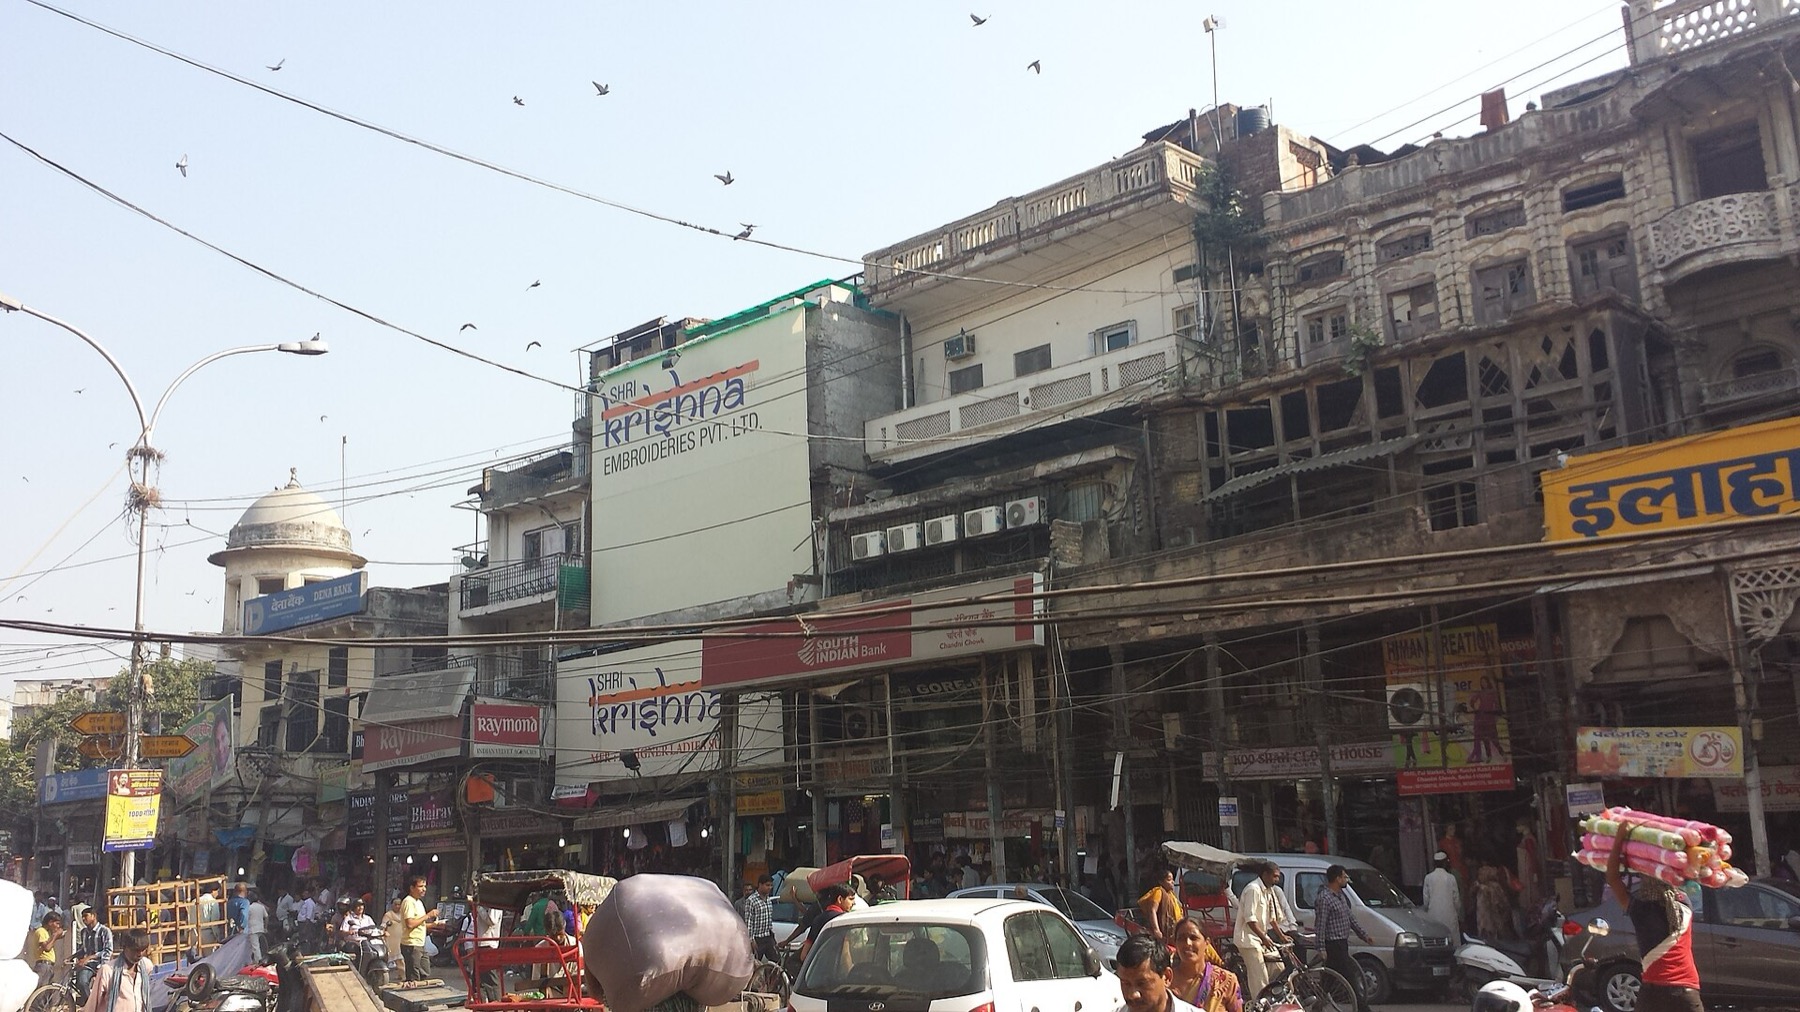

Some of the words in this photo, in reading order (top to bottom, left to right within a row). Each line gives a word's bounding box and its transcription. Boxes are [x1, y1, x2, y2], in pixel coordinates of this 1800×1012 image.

[609, 379, 637, 404] SHRI
[602, 370, 745, 449] krishna
[604, 431, 696, 476] EMBROIDERIES
[699, 423, 728, 447] PVT.
[732, 412, 763, 437] LTD.
[313, 587, 332, 601] DENA
[333, 582, 353, 597] BANK
[816, 635, 859, 651] SOUTH
[816, 647, 859, 664] INDIAN
[861, 642, 887, 657] Bank
[939, 641, 964, 650] Chandni
[964, 637, 985, 647] Chowk
[1441, 629, 1496, 655] REATION
[597, 670, 623, 692] SHRI
[588, 667, 722, 737] krishna
[477, 716, 538, 737] Raymond
[1340, 746, 1383, 760] HOUSE
